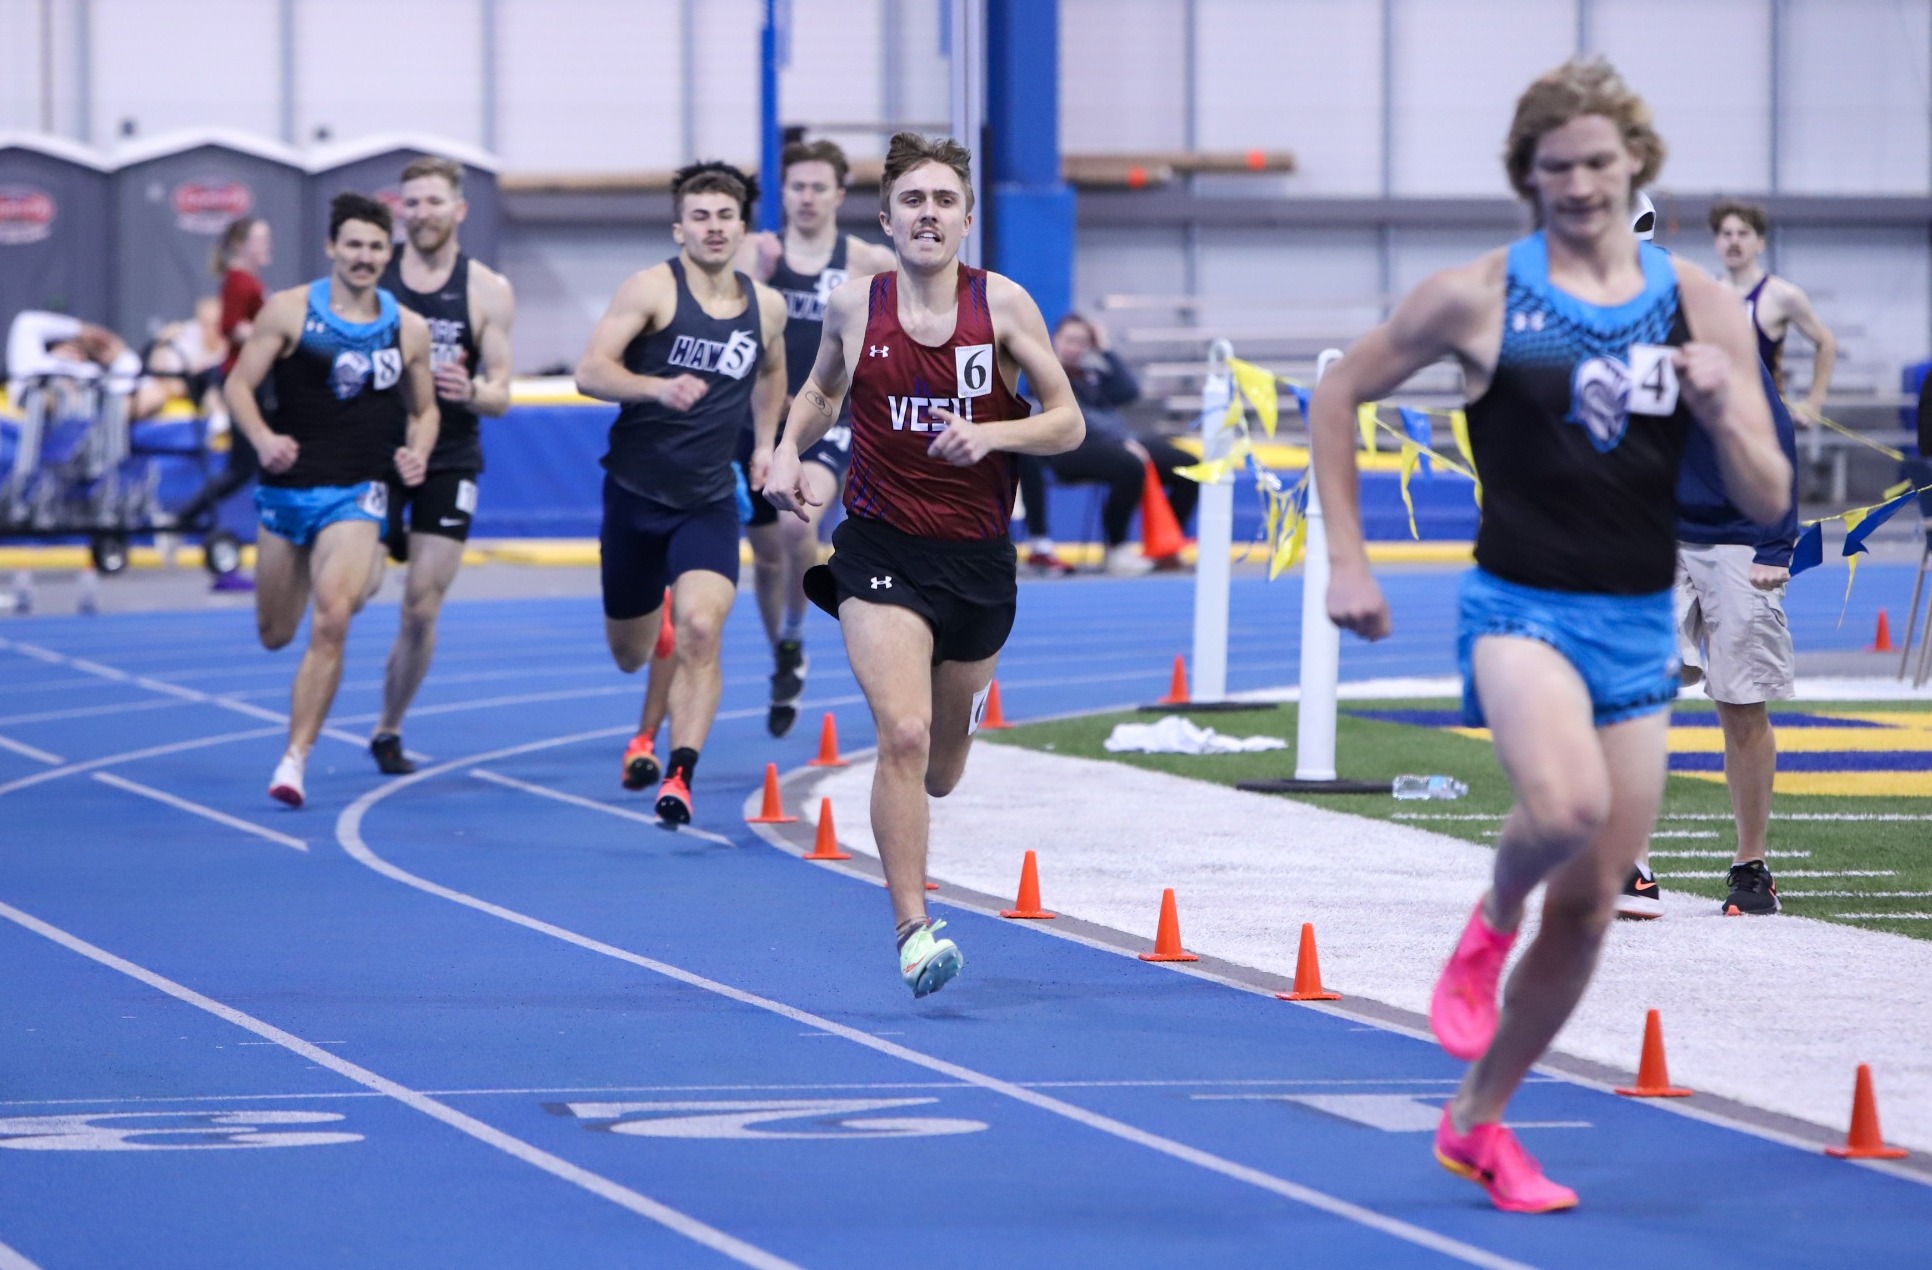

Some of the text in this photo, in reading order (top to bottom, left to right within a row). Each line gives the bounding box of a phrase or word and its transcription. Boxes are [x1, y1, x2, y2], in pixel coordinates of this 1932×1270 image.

[379, 352, 396, 381] 8
[726, 341, 750, 370] 5
[963, 349, 987, 390] 6
[1640, 356, 1665, 403] 4
[0, 1110, 366, 1151] 3
[545, 1097, 989, 1139] 2
